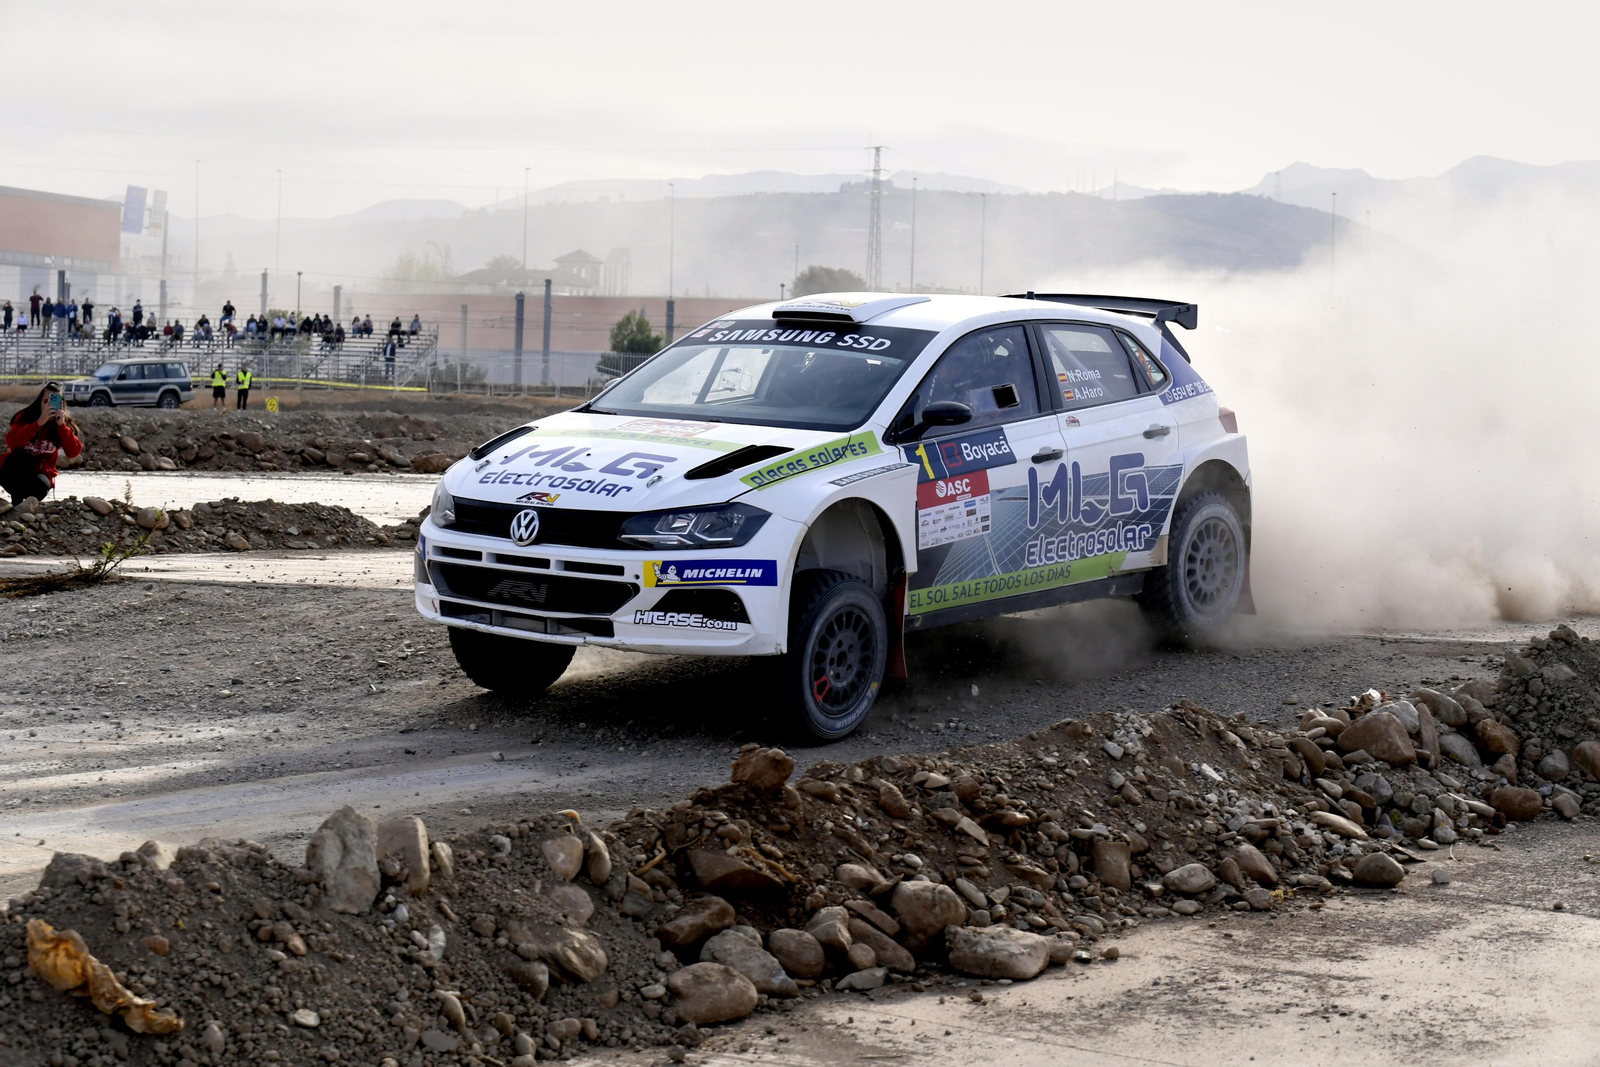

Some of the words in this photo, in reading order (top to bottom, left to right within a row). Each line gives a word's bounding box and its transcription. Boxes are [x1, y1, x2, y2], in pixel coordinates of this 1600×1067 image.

[708, 329, 837, 344] SAMSUNG
[837, 334, 891, 351] SSD
[1067, 369, 1102, 383] N.Roma
[1074, 386, 1104, 401] A.Haro
[1171, 386, 1188, 401] 654
[1186, 383, 1197, 397] 85
[669, 435, 714, 448] libres
[915, 443, 935, 480] 1
[947, 478, 971, 497] ASC
[682, 568, 763, 579] MICHELIN
[909, 593, 924, 609] EL
[926, 589, 949, 605] SOL
[952, 581, 982, 601] SALE
[983, 577, 1022, 595] TODOS
[1024, 570, 1045, 587] LOS
[1047, 564, 1072, 582] DIAS
